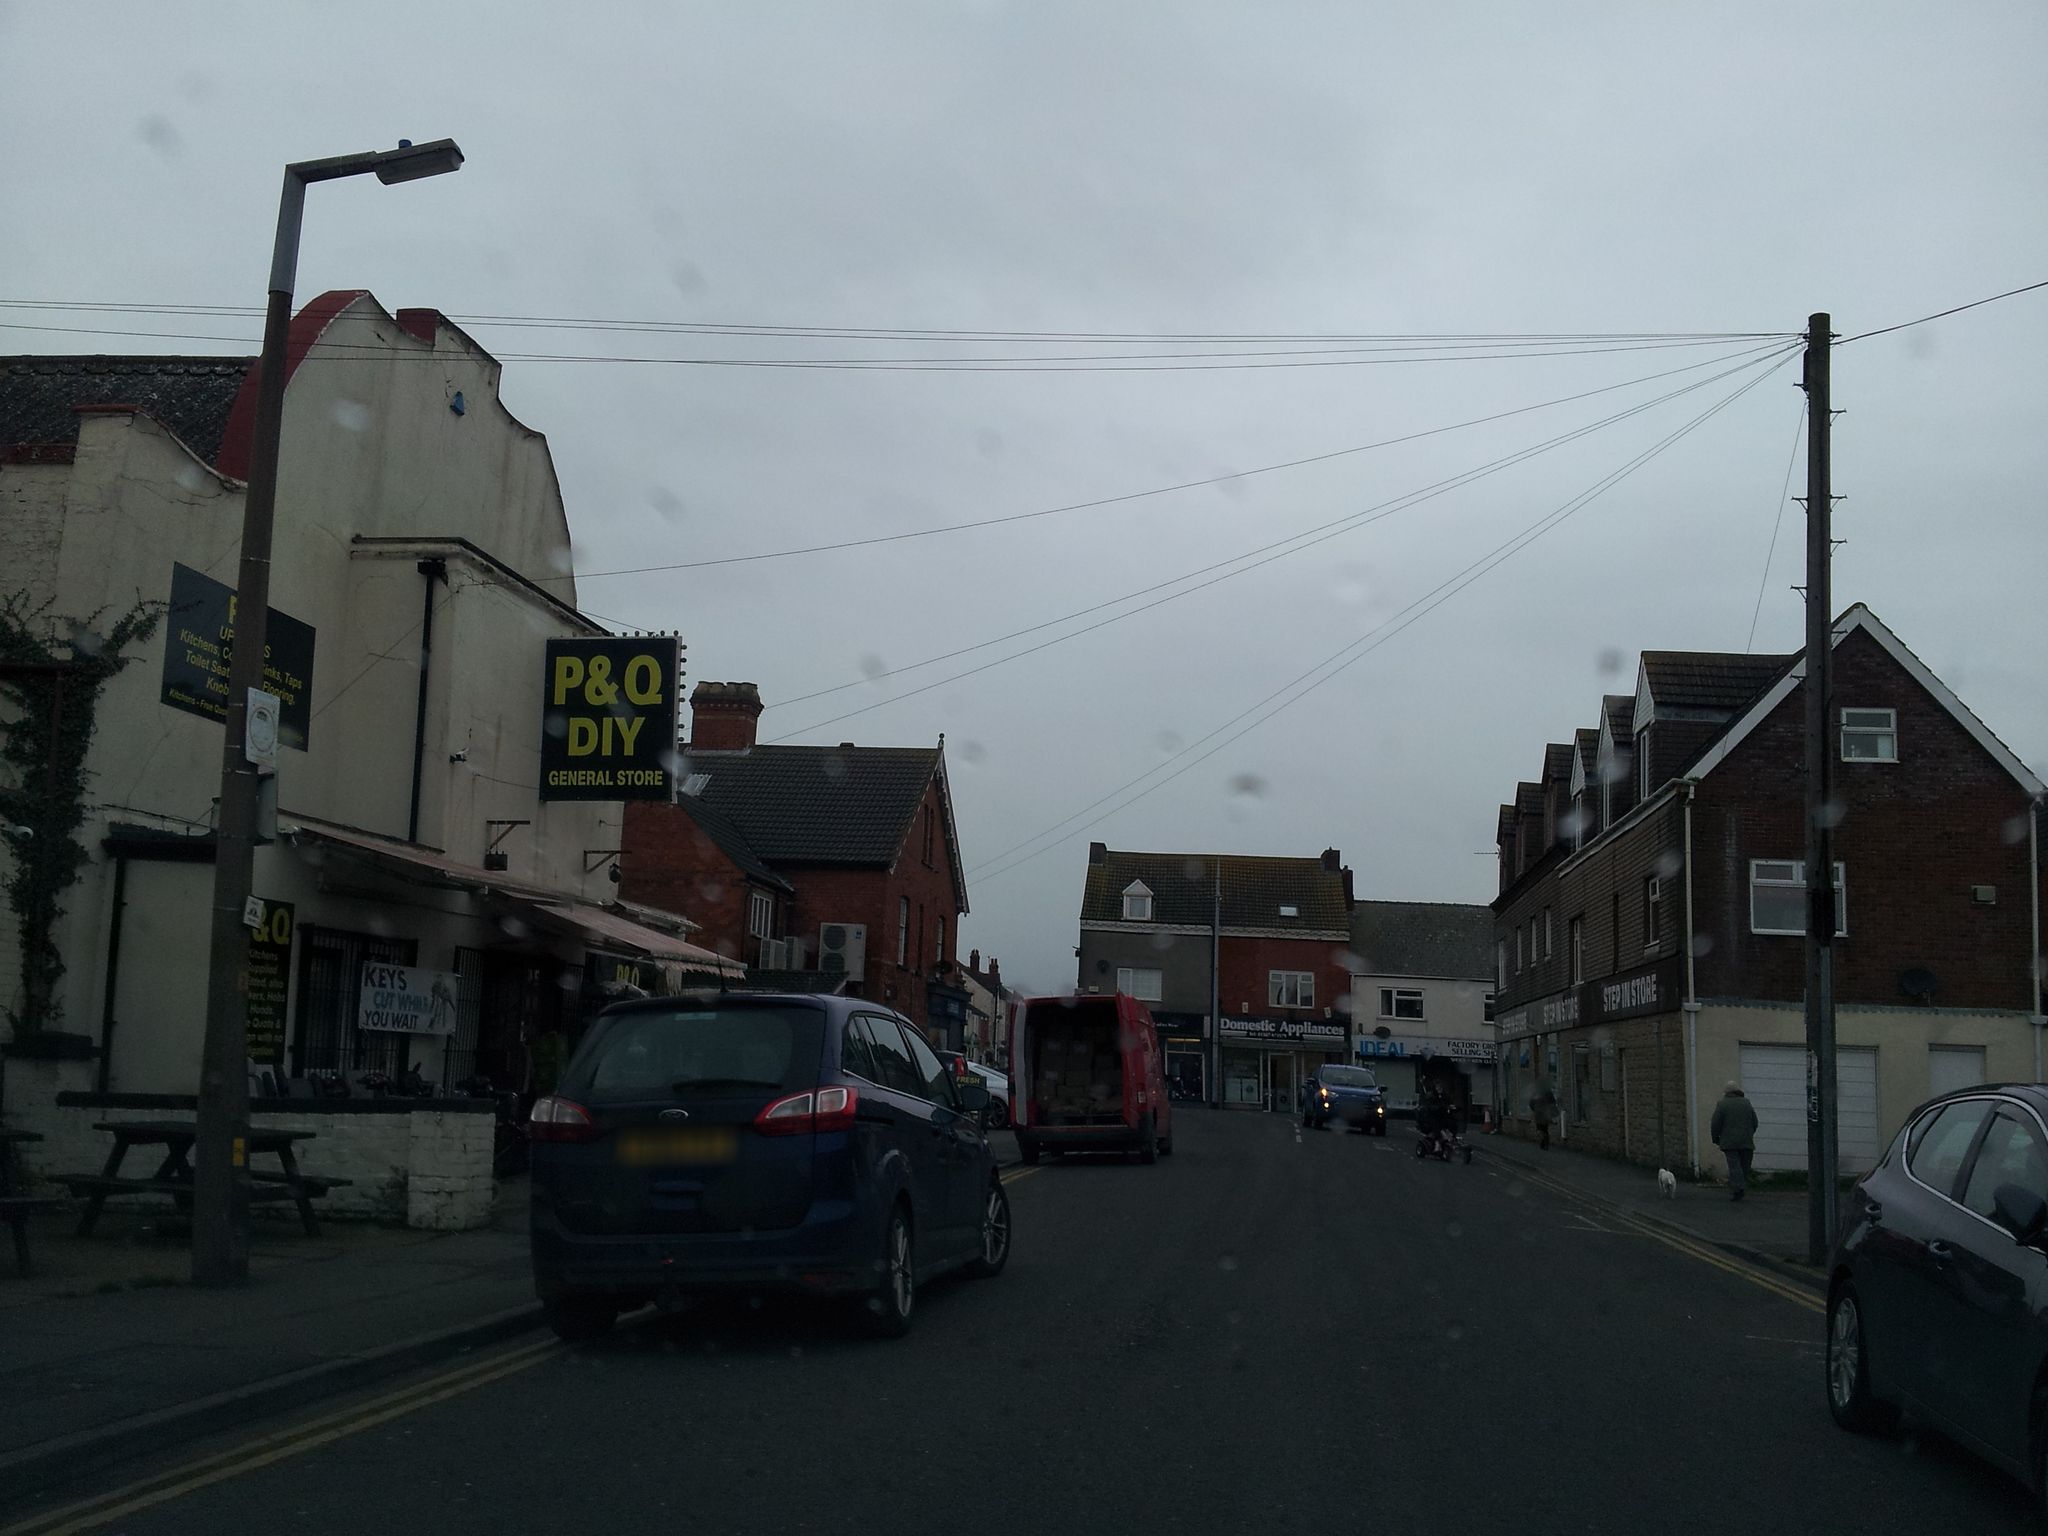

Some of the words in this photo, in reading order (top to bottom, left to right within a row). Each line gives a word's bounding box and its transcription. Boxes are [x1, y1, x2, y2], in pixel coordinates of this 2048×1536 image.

[185, 650, 209, 671] Toilet
[210, 660, 231, 680] Seat
[205, 677, 230, 696] Knob
[263, 664, 282, 685] inks,
[284, 672, 303, 690] Taps
[553, 654, 663, 706] P&Q
[568, 716, 646, 757] DIY
[548, 770, 614, 786] GENERAL
[616, 770, 664, 786] STORE
[364, 966, 407, 991] KEYS
[374, 991, 396, 1010] CUT
[1603, 984, 1621, 1012] STEP
[1622, 981, 1630, 1008] IN
[1631, 973, 1657, 1007] STORE
[364, 1010, 388, 1027] YOU
[392, 1013, 418, 1029] WAIT
[1220, 1017, 1275, 1033] Domestic
[1279, 1020, 1345, 1036] Appliances
[1360, 1040, 1408, 1056] IDEAL
[1448, 1041, 1479, 1049] FACTORY
[1451, 1048, 1481, 1056] SELLING
